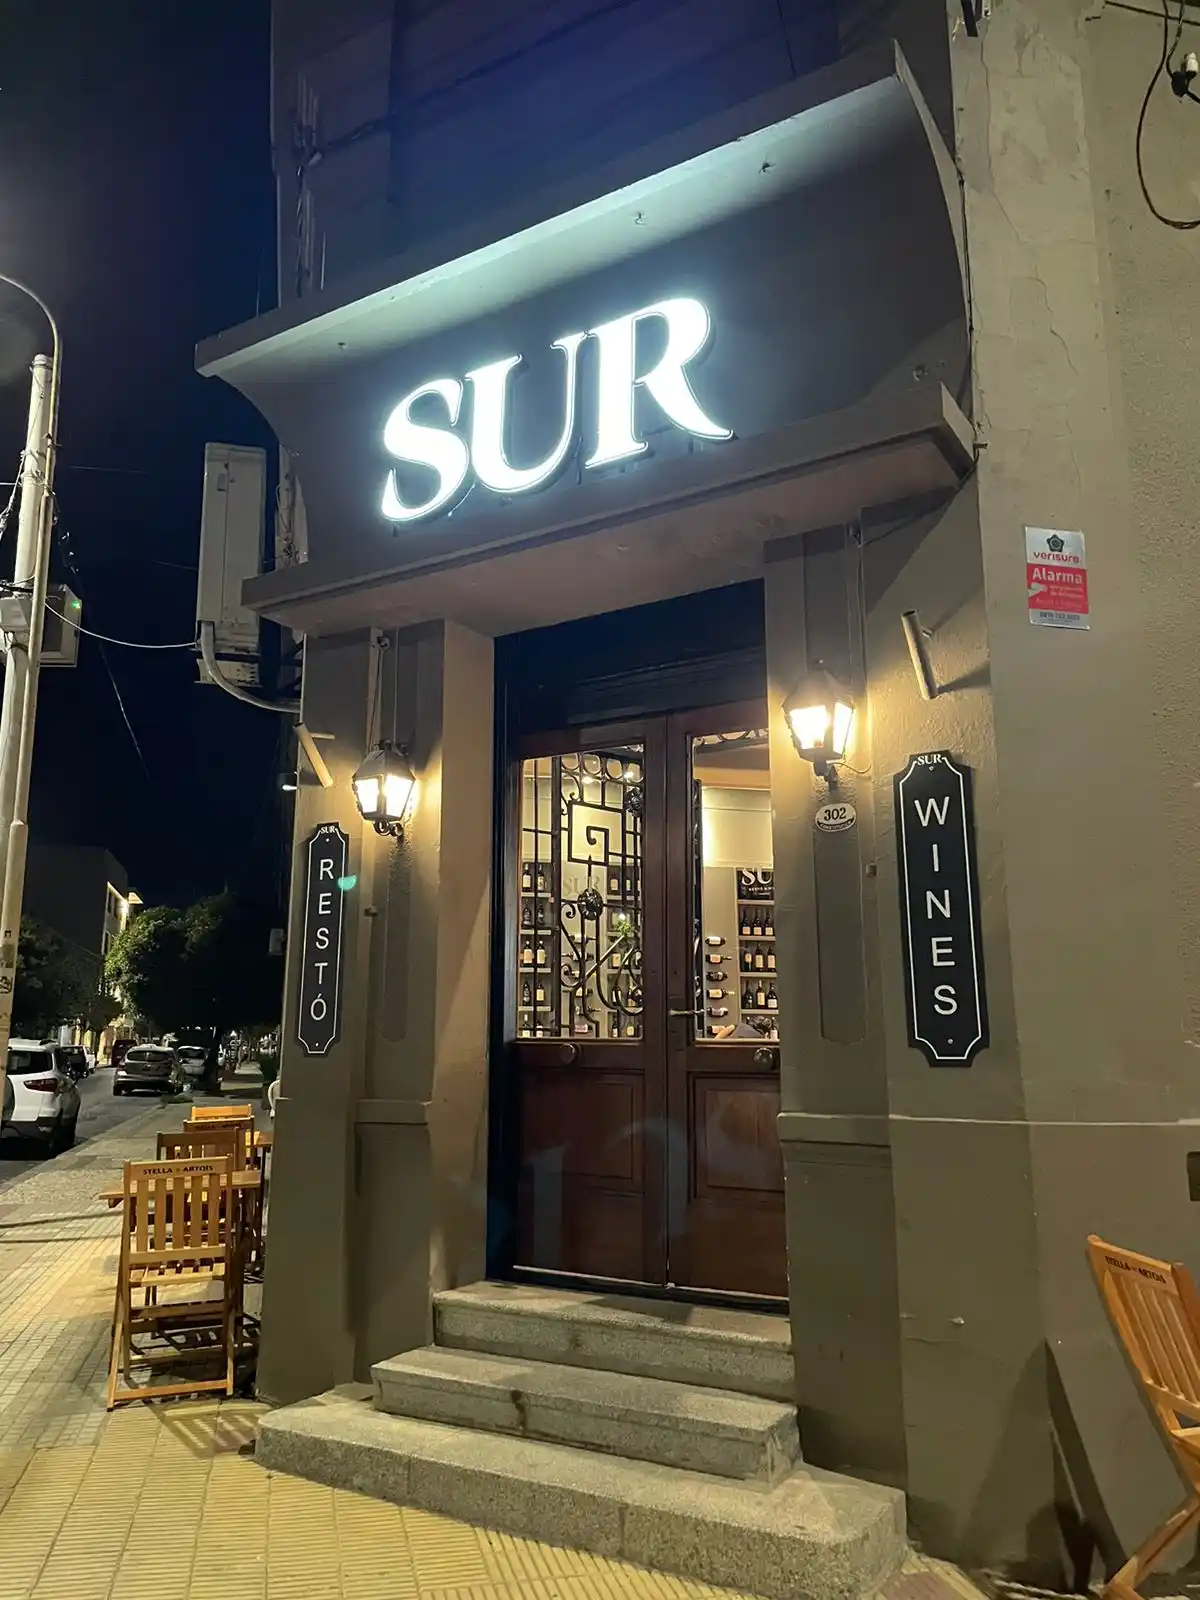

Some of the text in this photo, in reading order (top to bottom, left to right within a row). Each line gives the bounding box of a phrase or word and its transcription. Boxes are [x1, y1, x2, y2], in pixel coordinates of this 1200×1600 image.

[381, 298, 734, 521] SUR
[1032, 567, 1083, 585] Alarma
[917, 753, 943, 766] SUR
[823, 807, 847, 821] 302
[320, 825, 336, 834] SUR
[914, 796, 958, 1015] WINES
[310, 858, 334, 1021] RESTÓ
[143, 1164, 214, 1175] STELLA ARTOIS
